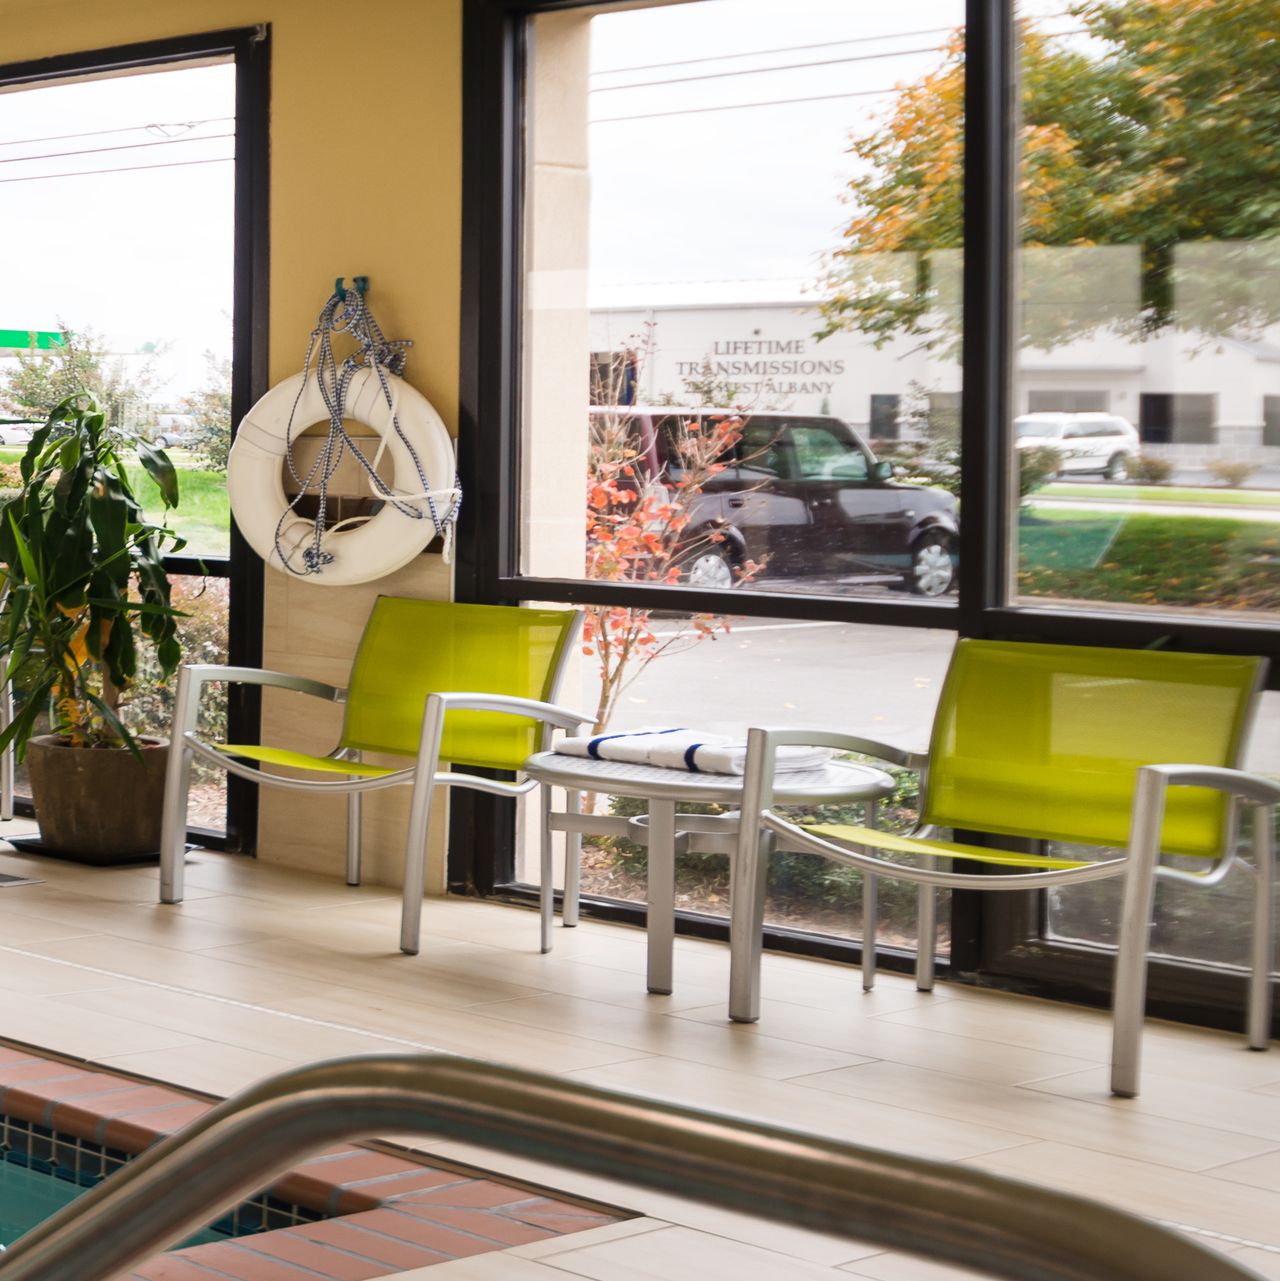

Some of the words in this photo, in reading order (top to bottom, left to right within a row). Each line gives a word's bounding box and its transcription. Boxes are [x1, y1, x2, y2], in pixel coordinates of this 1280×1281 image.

[714, 340, 806, 355] LIFETIME
[676, 360, 845, 375] TRANSMISSIONS
[768, 381, 834, 394] ALBANY
